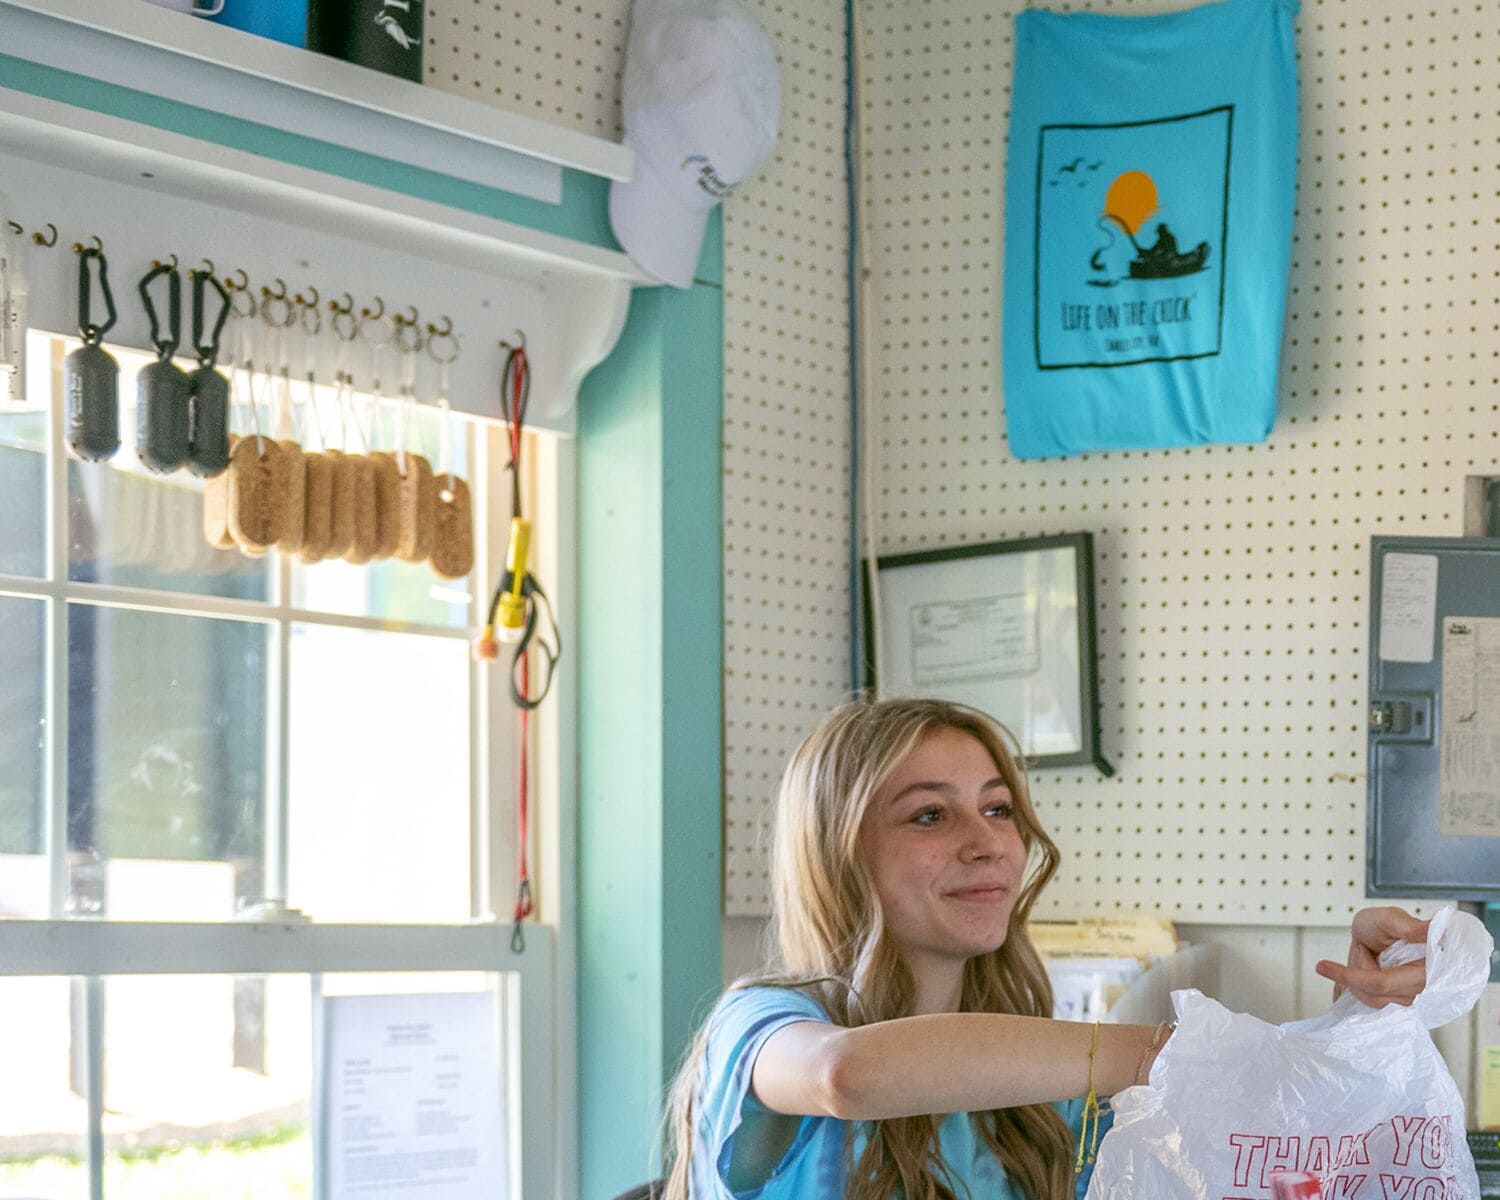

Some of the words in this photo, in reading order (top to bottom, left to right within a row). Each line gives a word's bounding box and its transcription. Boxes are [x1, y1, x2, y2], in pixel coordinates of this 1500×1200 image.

[1061, 302, 1091, 331] LIFE
[1096, 304, 1120, 330] ON
[1123, 301, 1147, 326] THE
